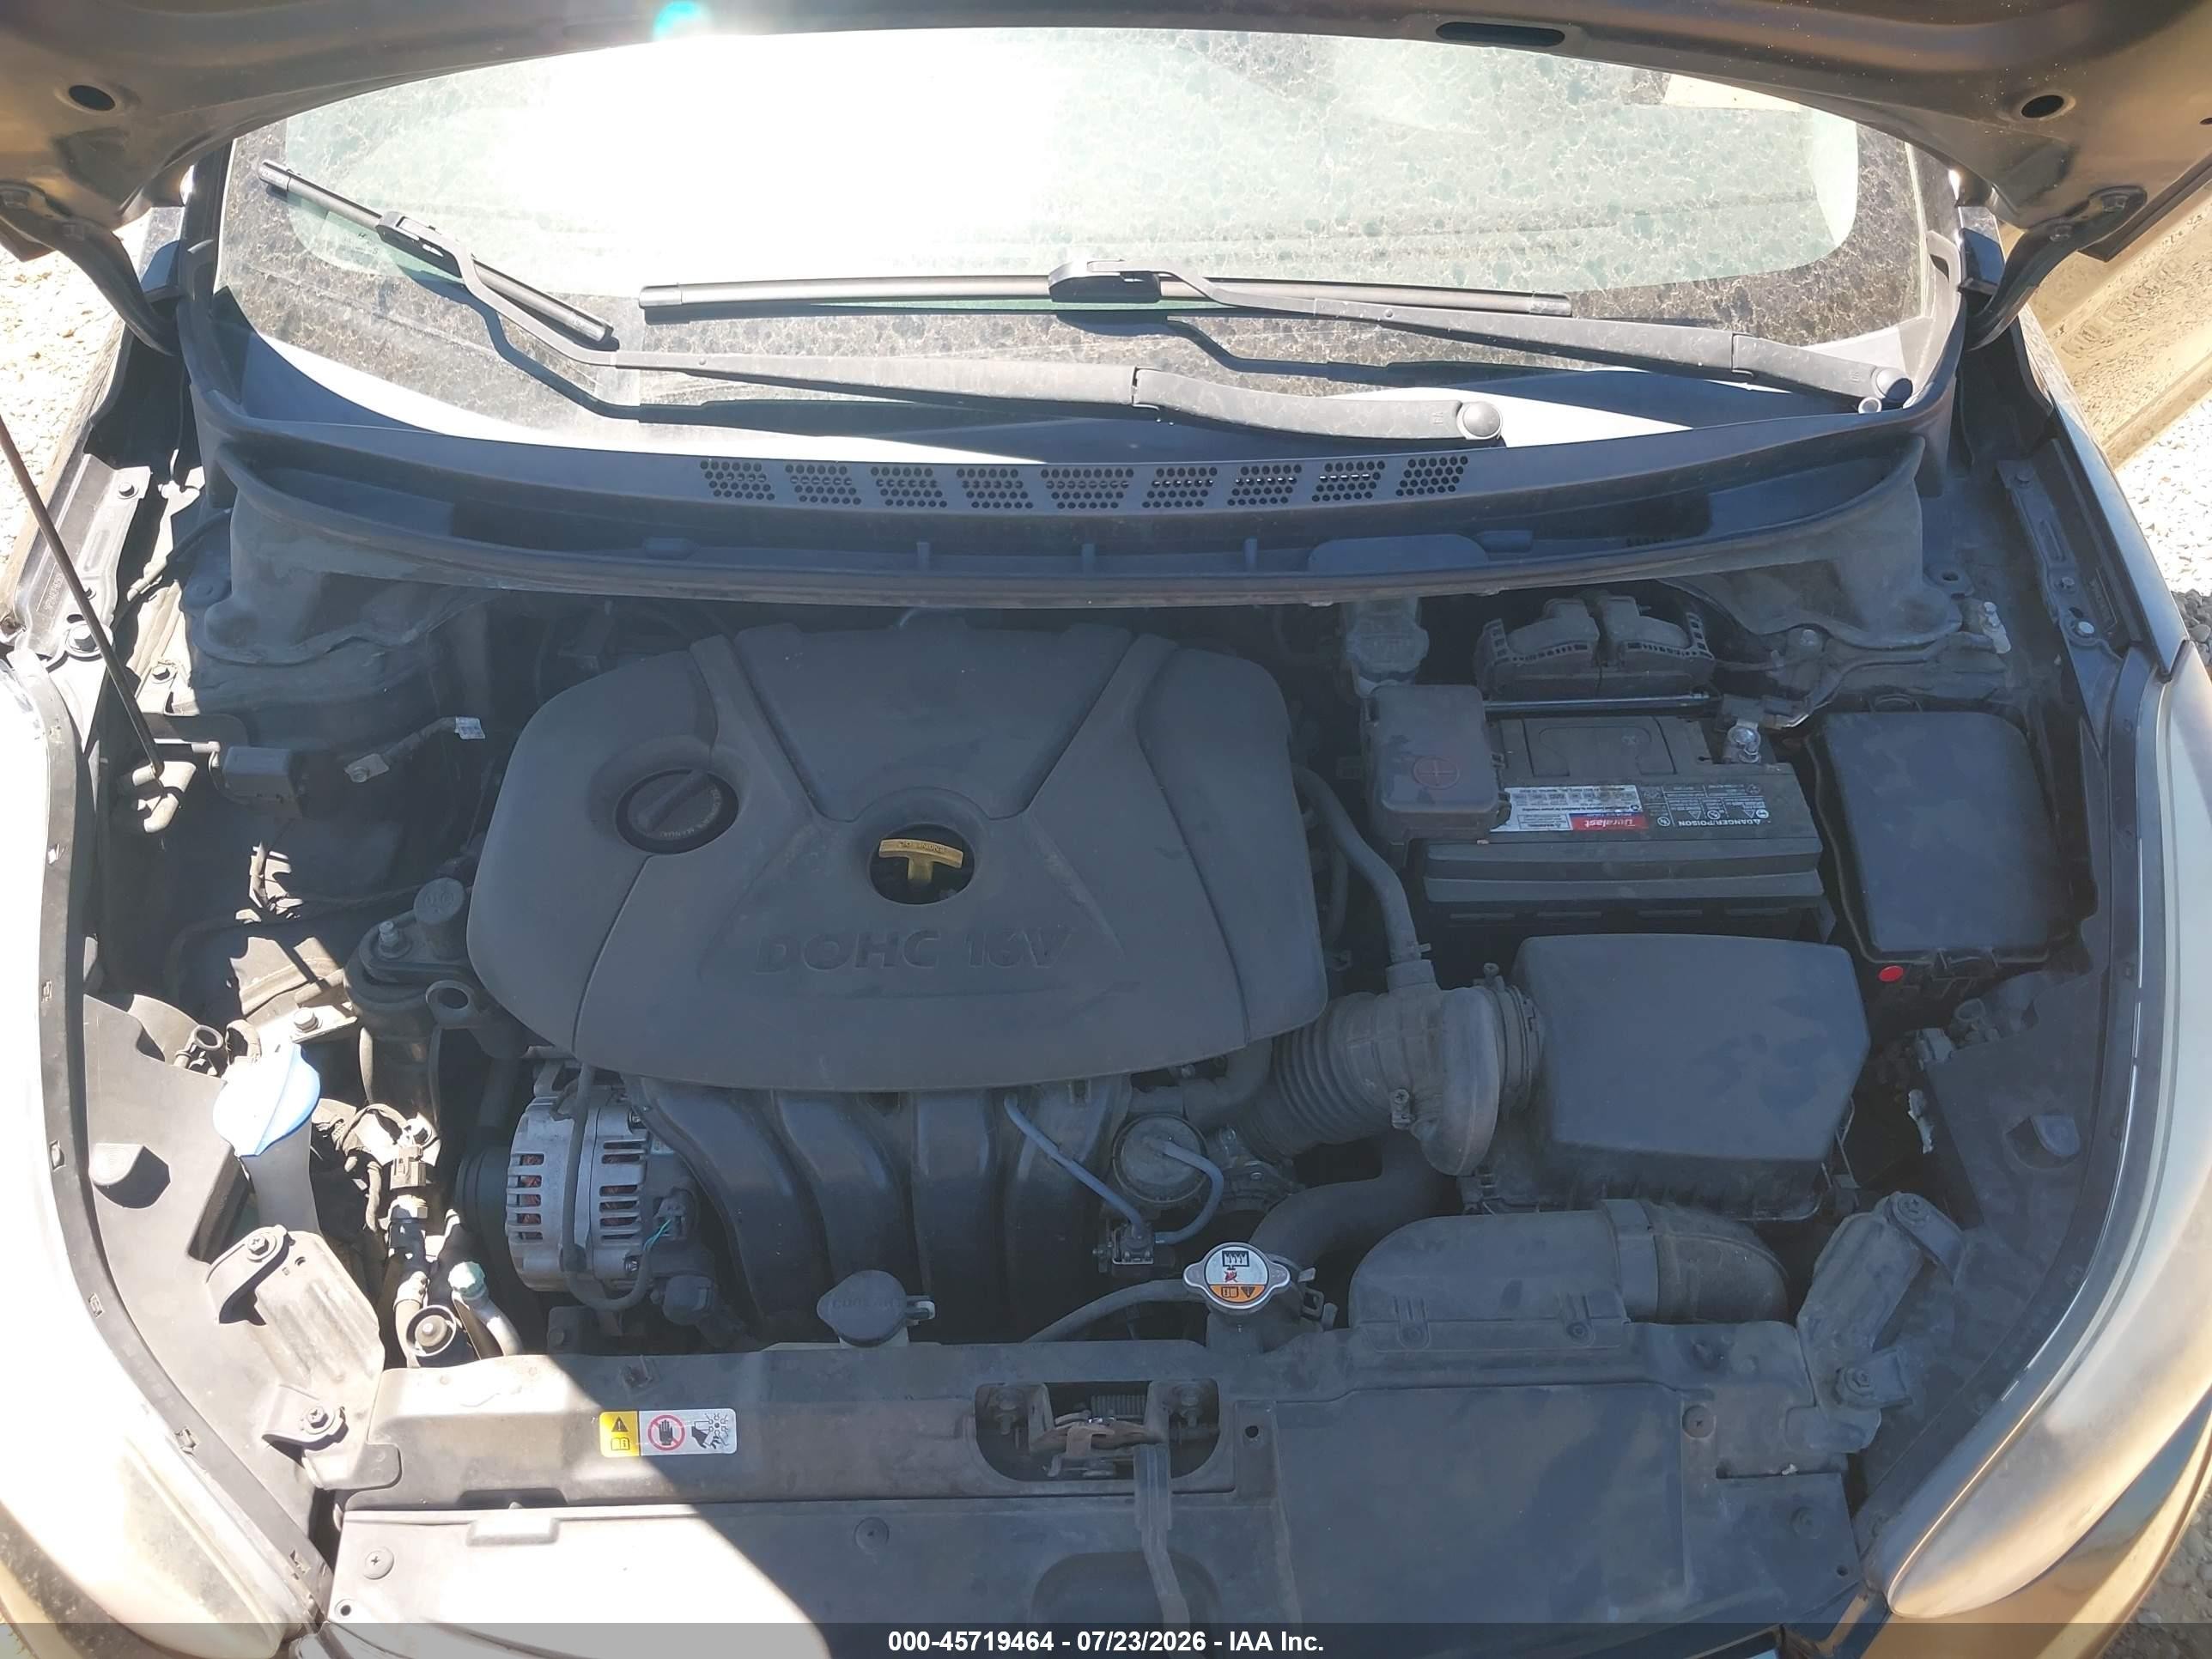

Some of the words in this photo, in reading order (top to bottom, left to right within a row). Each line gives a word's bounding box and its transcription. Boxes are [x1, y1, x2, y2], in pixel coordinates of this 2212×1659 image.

[1585, 818, 1635, 828] Duralast
[751, 930, 941, 975] DOHC
[963, 928, 1072, 969] 16V
